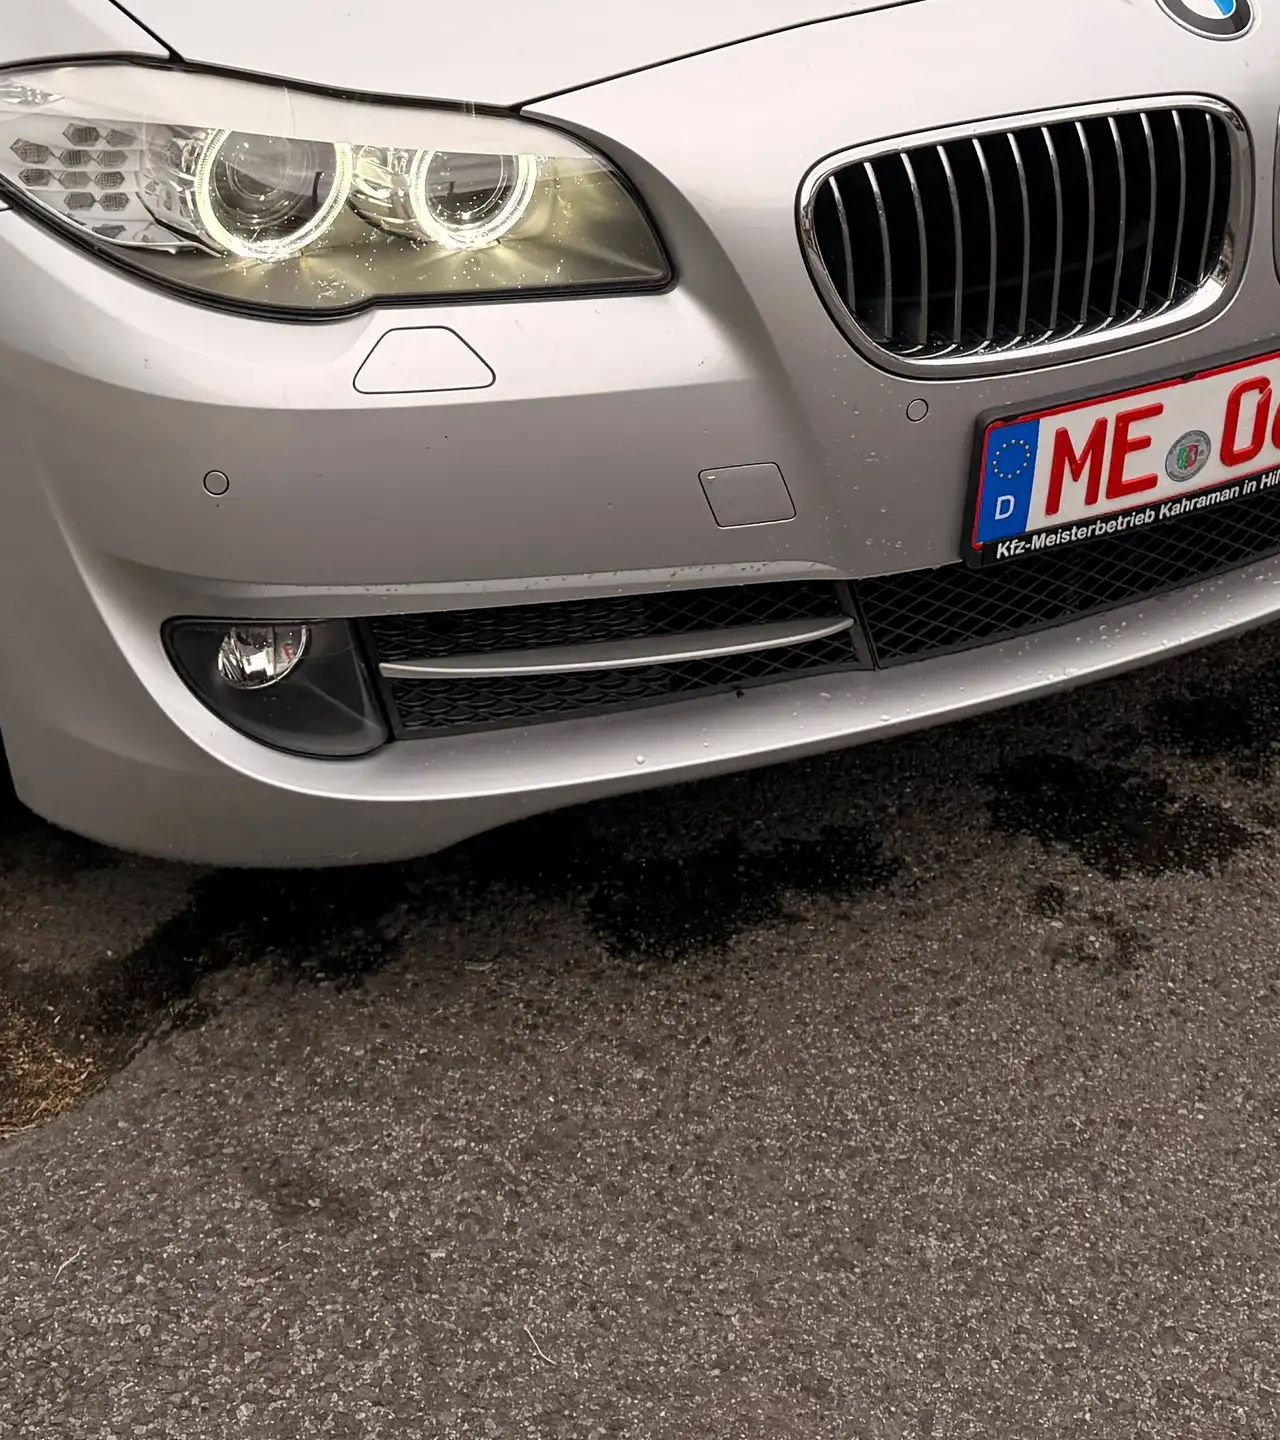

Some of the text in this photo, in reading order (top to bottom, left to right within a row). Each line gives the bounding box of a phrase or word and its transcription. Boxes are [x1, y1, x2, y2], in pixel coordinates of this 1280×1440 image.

[1044, 402, 1164, 516] ME
[994, 495, 1016, 520] D
[996, 507, 1155, 559] Kfz-Meisterbetrieb
[1158, 486, 1240, 520] Kahraman
[1242, 479, 1257, 496] in
